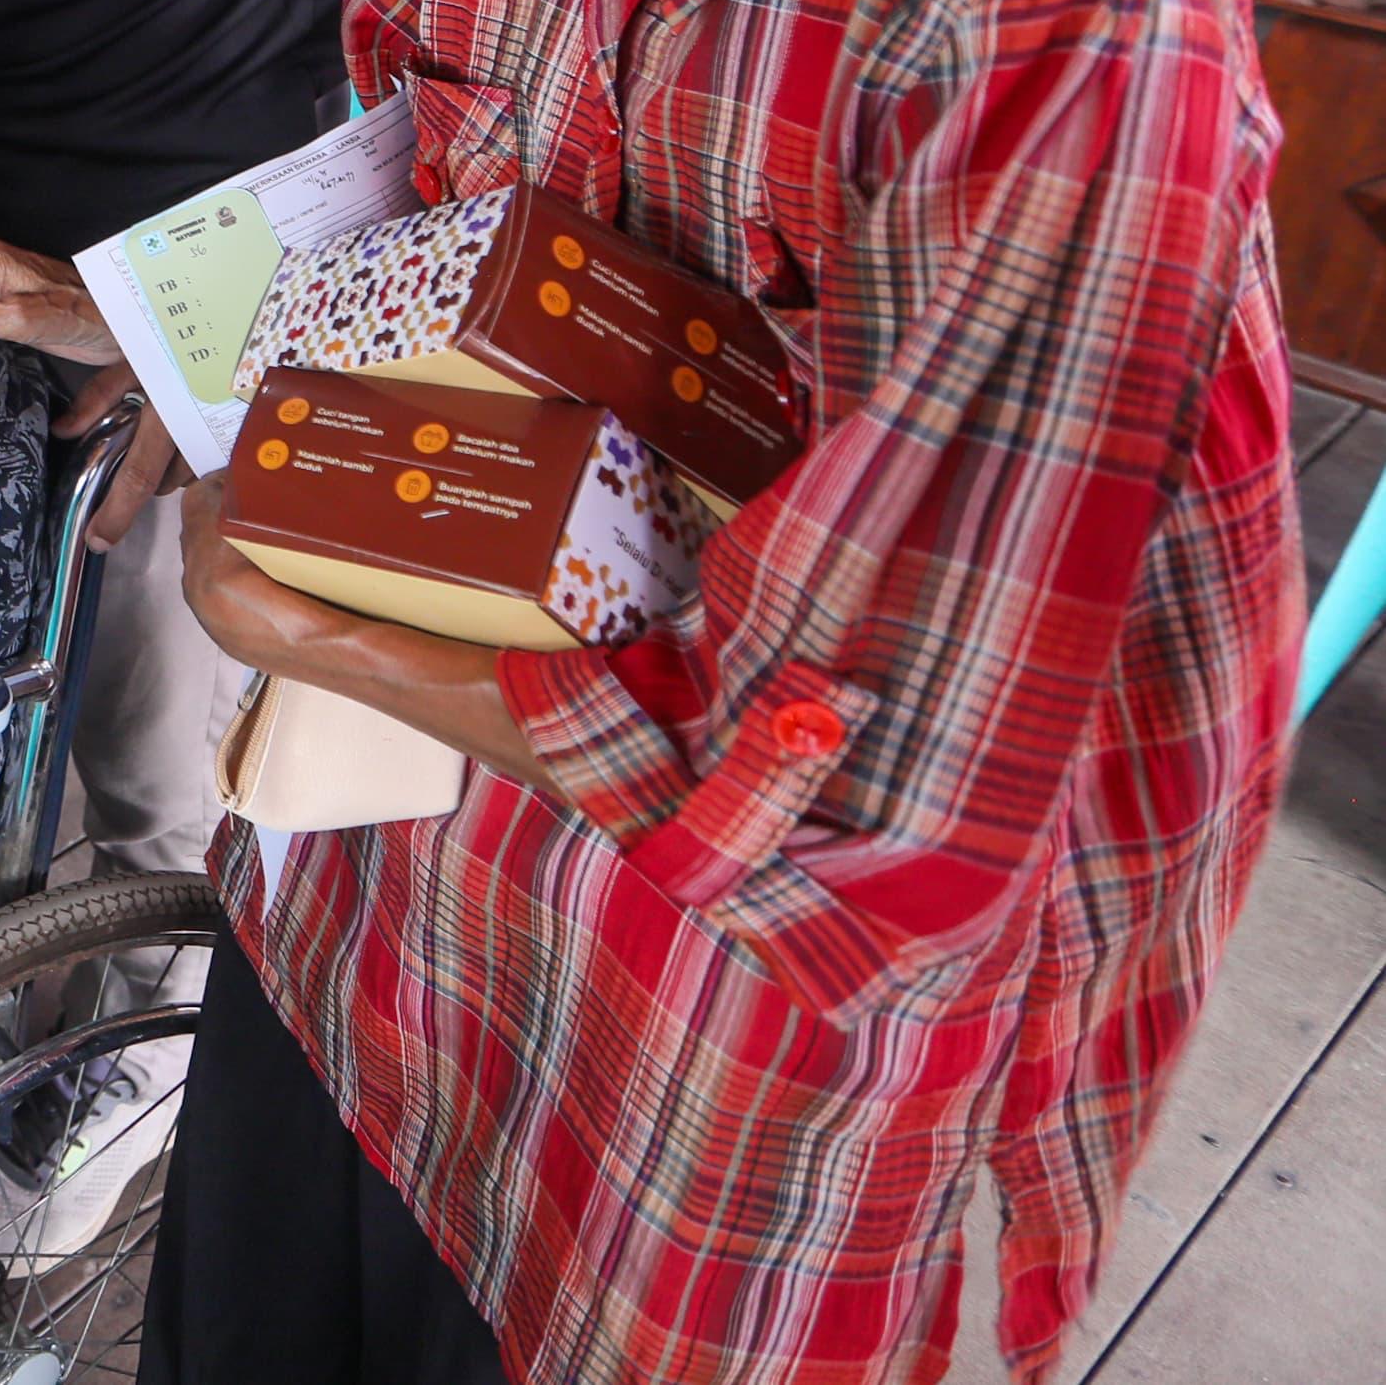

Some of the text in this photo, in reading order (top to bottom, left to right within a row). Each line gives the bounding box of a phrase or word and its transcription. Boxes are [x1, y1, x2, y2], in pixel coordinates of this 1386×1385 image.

[294, 152, 327, 170] DEWASA
[157, 278, 178, 294] TB
[167, 301, 189, 317] BB
[178, 324, 197, 340] LP
[188, 347, 210, 363] TD
[316, 406, 336, 419] Cuci
[312, 416, 384, 437] sebelum makan
[296, 449, 375, 474] Makanlah sambil
[452, 443, 536, 468] sebelum makan
[293, 459, 324, 474] duduk
[437, 480, 533, 511] Buanglah sampah
[434, 492, 519, 519] pada tempatnya
